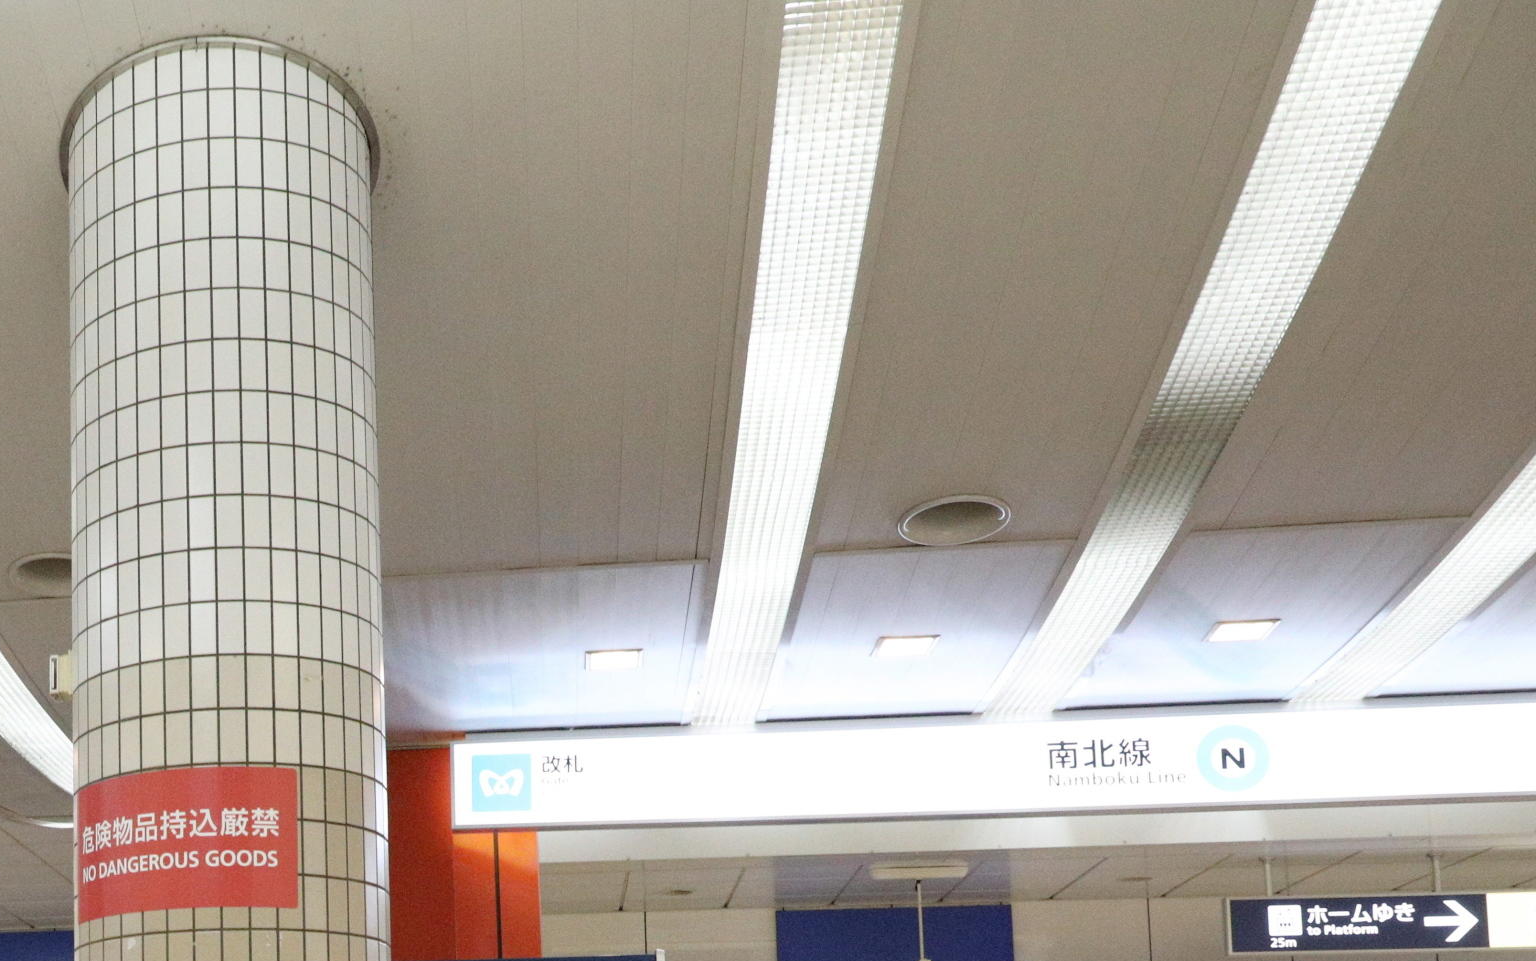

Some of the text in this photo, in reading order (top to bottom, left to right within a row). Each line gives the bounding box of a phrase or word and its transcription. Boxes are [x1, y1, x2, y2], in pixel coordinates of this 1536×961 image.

[542, 754, 584, 773] 改札
[1047, 738, 1152, 769] 南北線
[1220, 747, 1246, 769] N
[1048, 770, 1186, 786] Namboku Line
[82, 807, 279, 855] 危険物品持込厳禁
[82, 849, 278, 884] NO DANGEROUS GOODS
[1306, 902, 1416, 924] ホームゆき
[1306, 923, 1379, 936] to Platform
[1269, 936, 1298, 949] 25m
